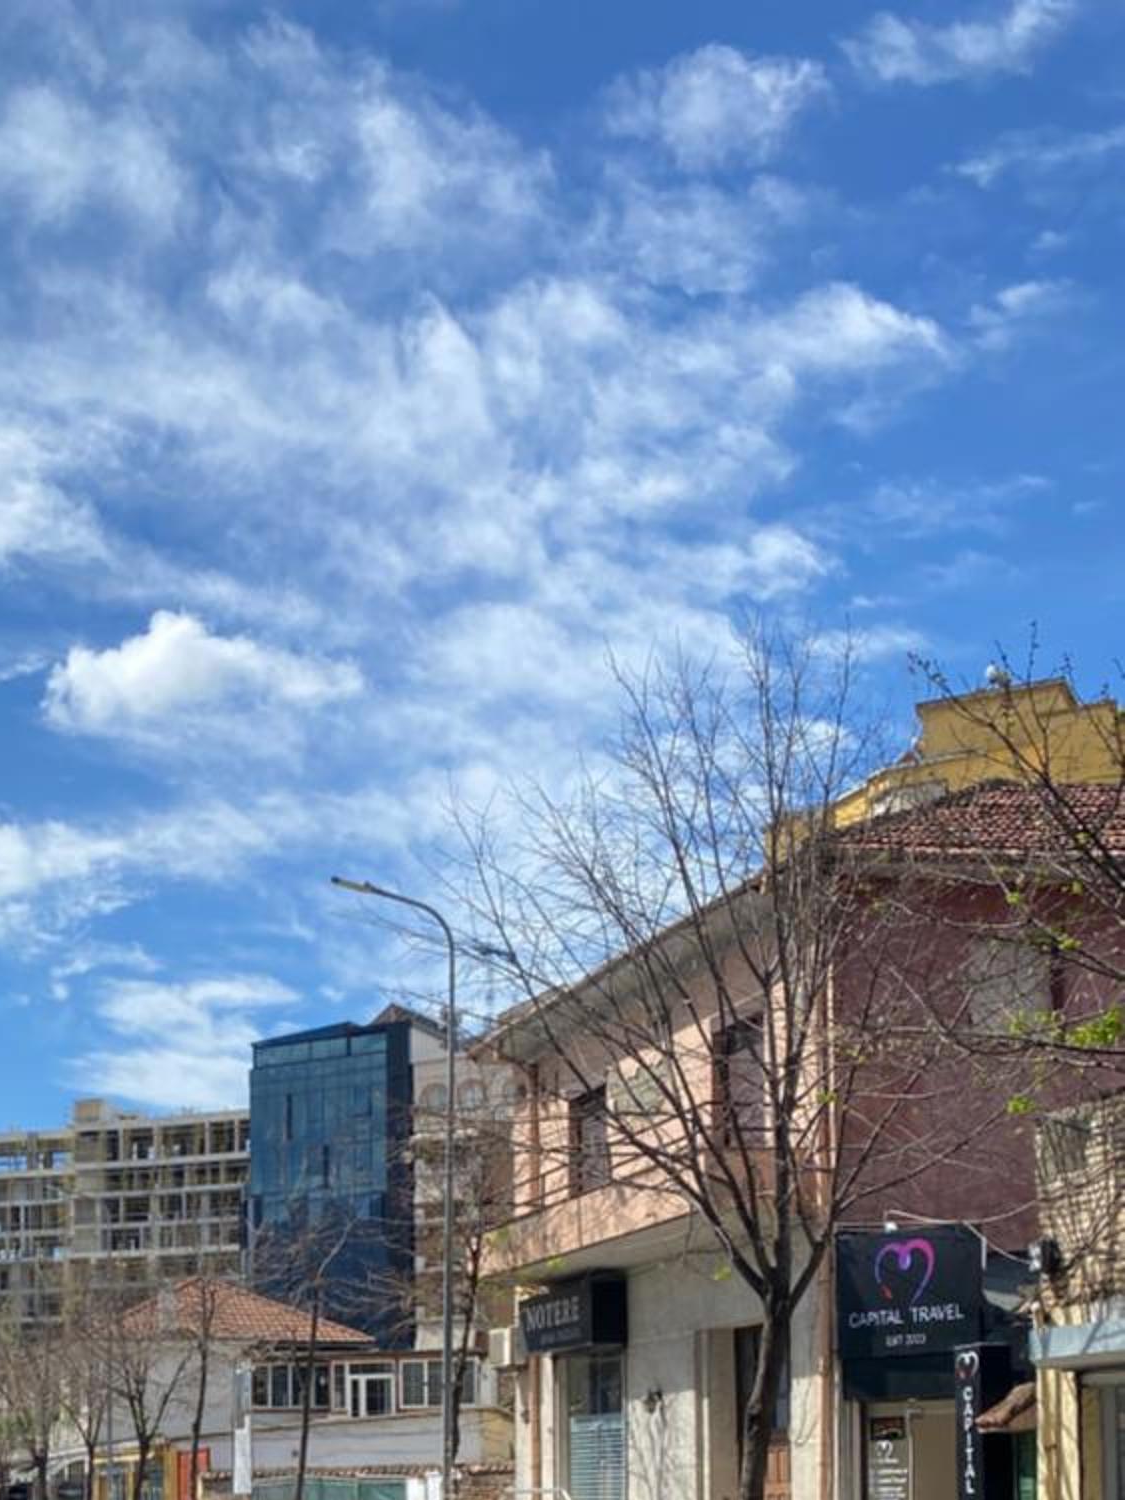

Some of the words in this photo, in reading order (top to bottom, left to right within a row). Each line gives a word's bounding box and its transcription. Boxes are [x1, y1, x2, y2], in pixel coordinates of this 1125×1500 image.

[848, 1309, 904, 1329] CAPITAL
[909, 1304, 965, 1322] TRAVEL
[962, 1386, 975, 1494] CAPITAL
